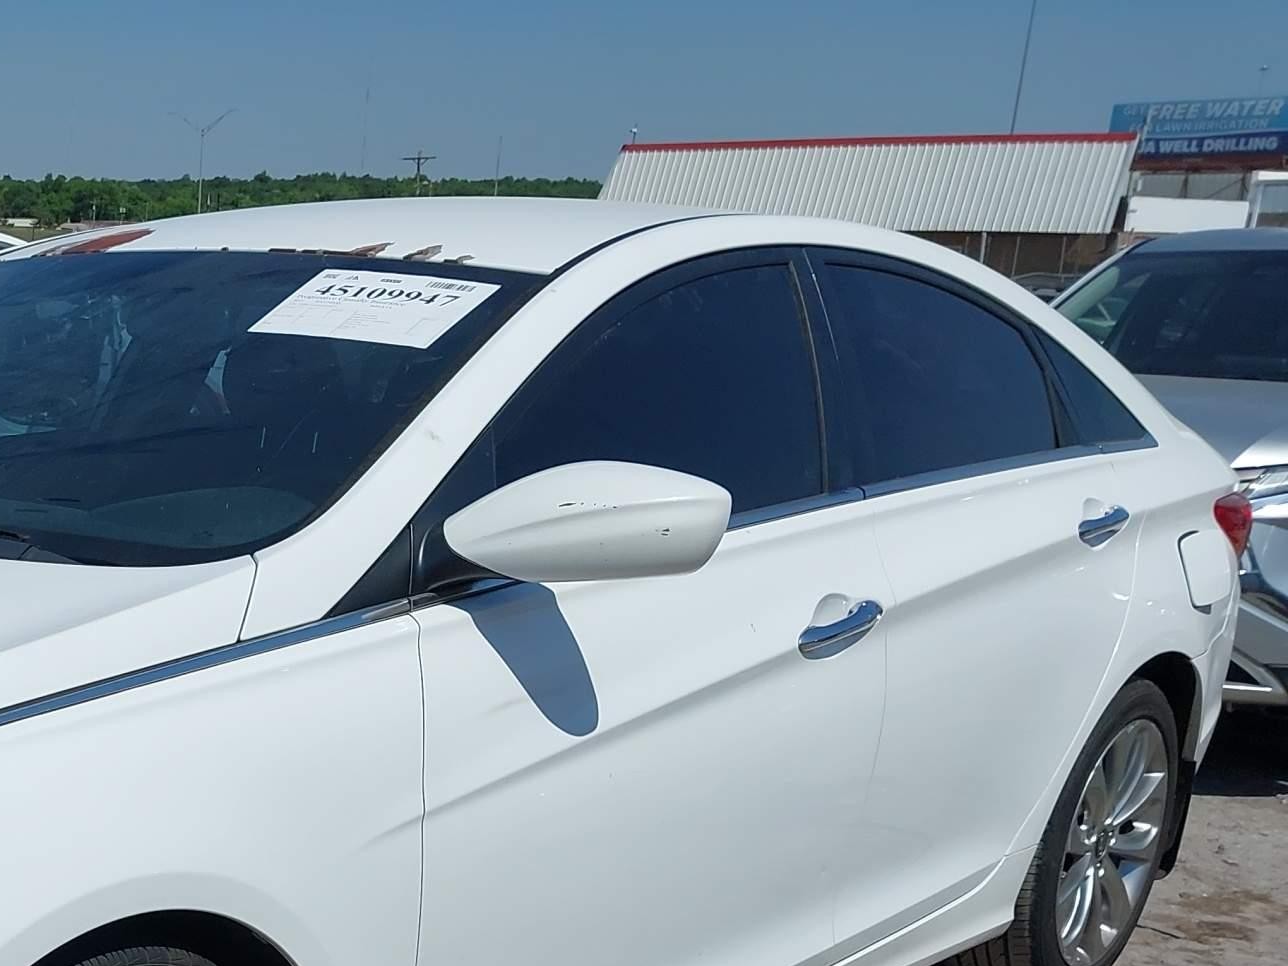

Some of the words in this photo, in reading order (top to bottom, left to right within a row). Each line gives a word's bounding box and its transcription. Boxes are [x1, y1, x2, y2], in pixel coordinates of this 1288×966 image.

[1148, 103, 1199, 120] FREE
[1207, 99, 1284, 117] WATER
[1155, 122, 1191, 132] LAWN
[1194, 118, 1269, 130] IRRIGATION
[1159, 139, 1199, 153] WELL
[1202, 137, 1278, 152] DRILLING
[315, 284, 461, 306] 45109947
